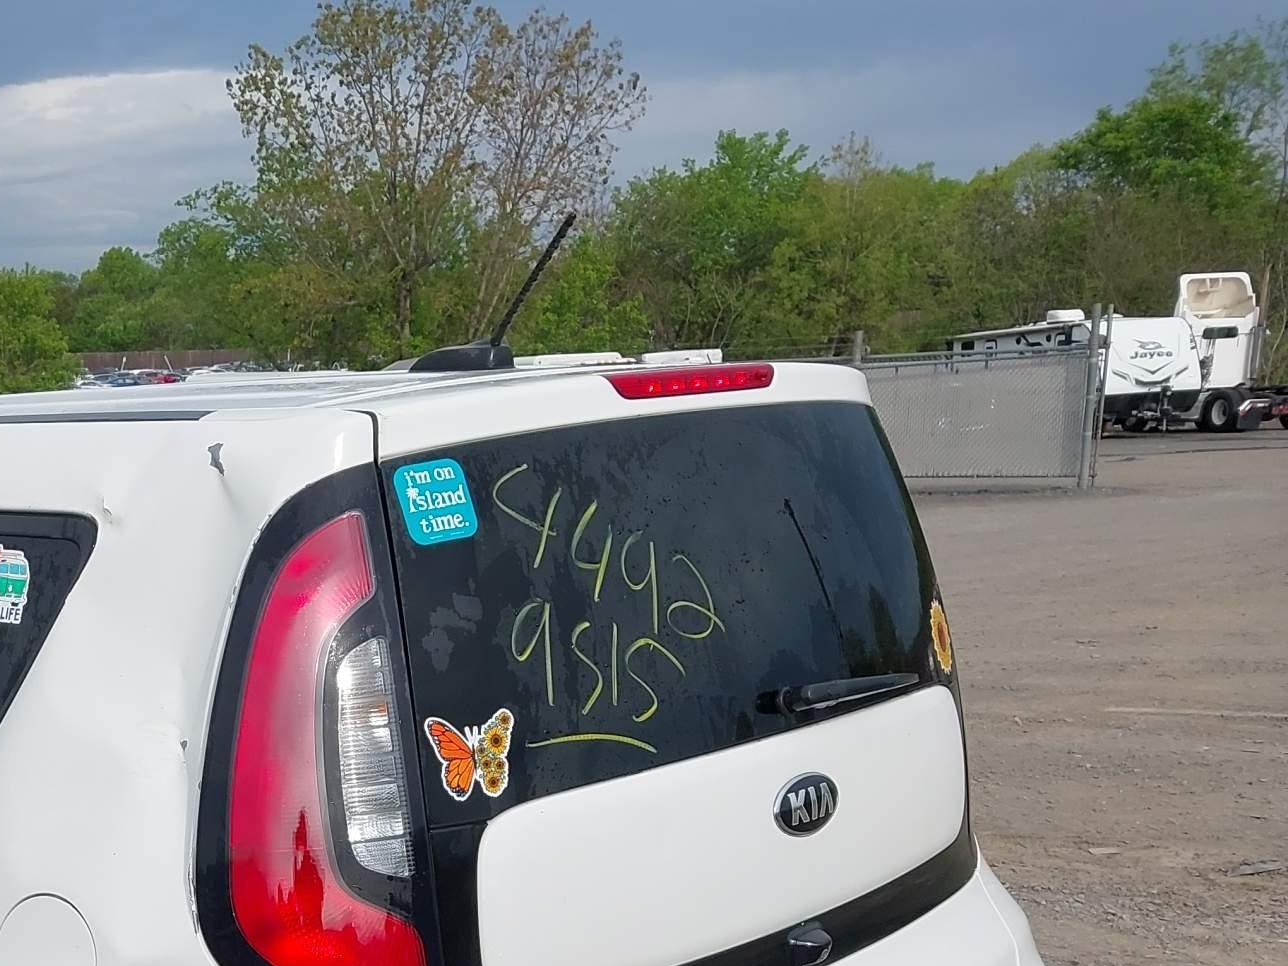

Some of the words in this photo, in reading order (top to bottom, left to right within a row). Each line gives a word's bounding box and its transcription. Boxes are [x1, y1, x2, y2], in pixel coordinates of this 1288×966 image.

[433, 466, 455, 481] on
[419, 513, 470, 533] time.
[493, 463, 726, 639] 4492
[0, 606, 21, 622] LIFE
[786, 781, 834, 826] KIA
